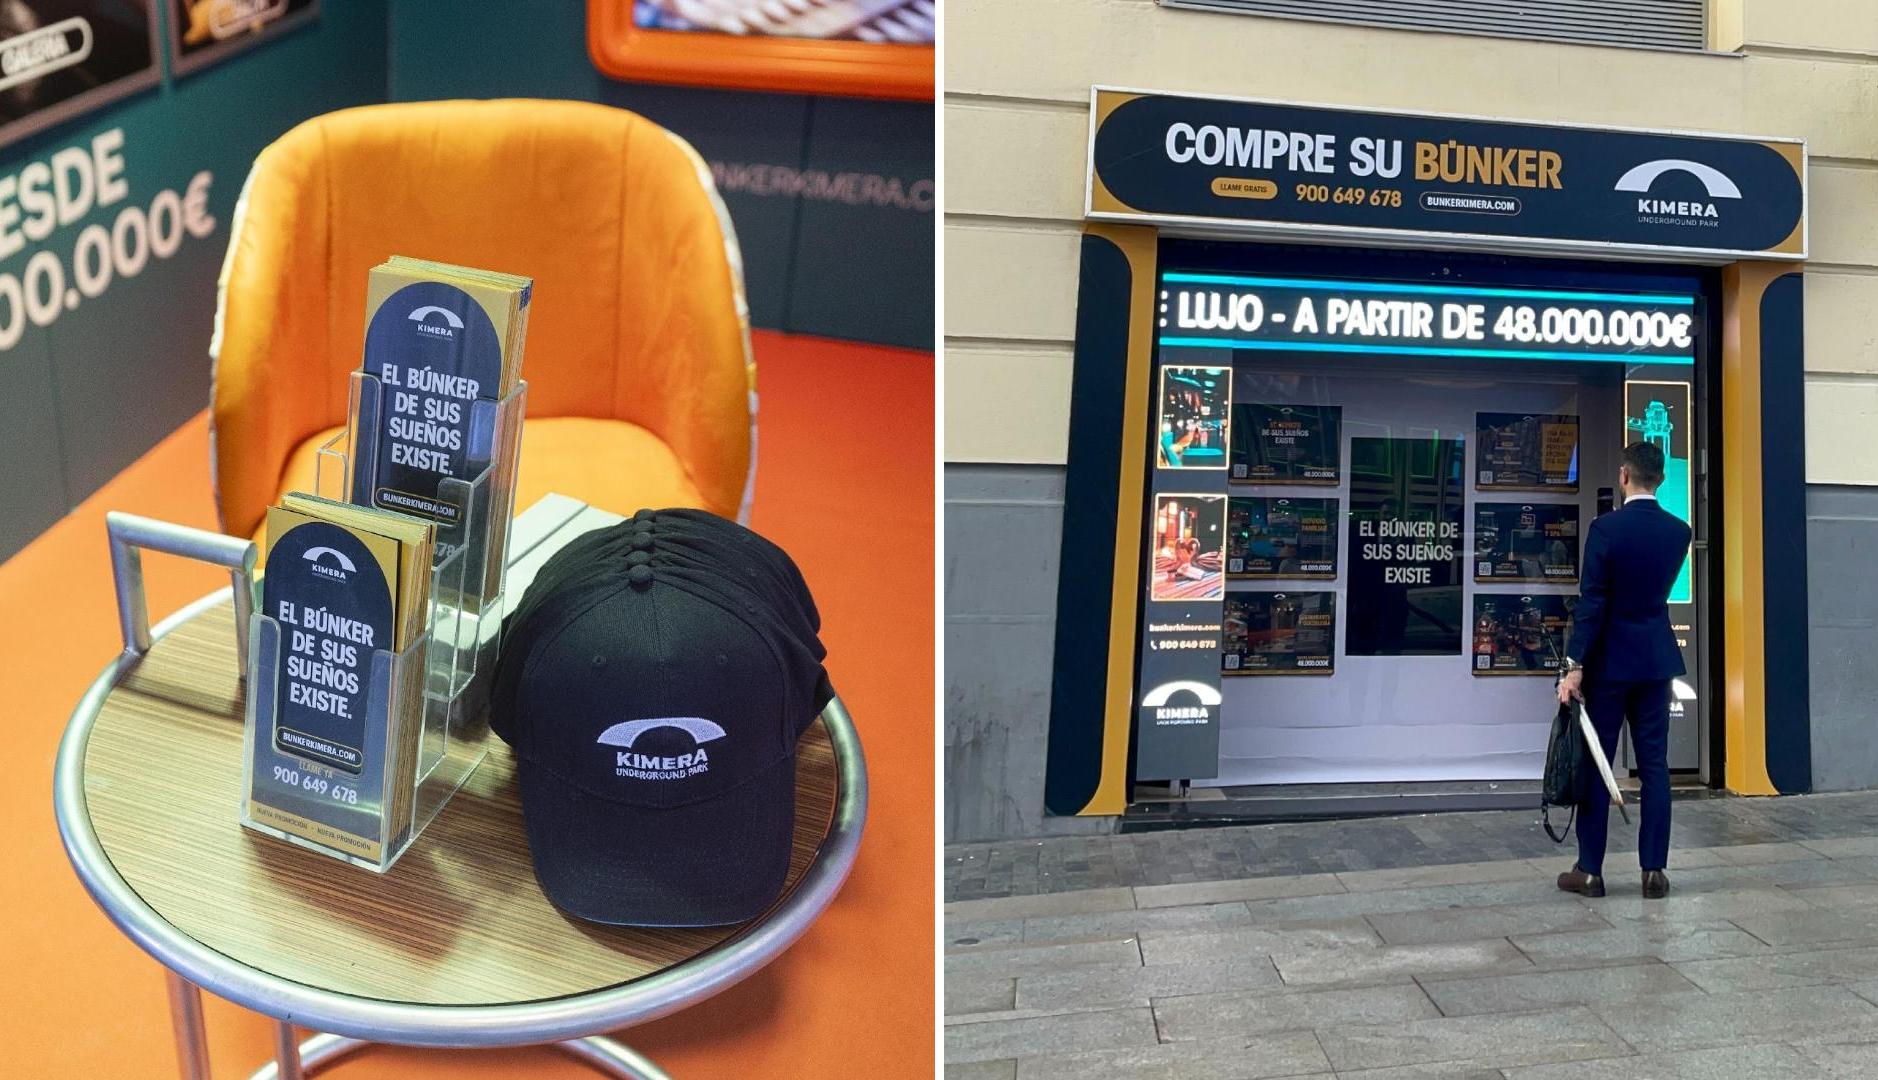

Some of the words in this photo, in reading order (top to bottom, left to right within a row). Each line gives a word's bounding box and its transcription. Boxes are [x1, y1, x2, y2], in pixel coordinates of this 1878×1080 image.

[1166, 122, 1335, 173] COMPRE
[1349, 137, 1402, 179] SU
[1296, 184, 1328, 202] 900
[1333, 186, 1364, 205] 649
[1369, 189, 1402, 208] 678
[1427, 196, 1515, 211] BUNKERKIMERA.COM
[1638, 199, 1719, 218] KIMERA
[1638, 216, 1697, 226] UNDERGROUND
[1700, 220, 1719, 228] PARK
[417, 324, 453, 337] KIMERA
[1178, 291, 1264, 332] LUJO
[1292, 297, 1319, 334] A
[1327, 298, 1433, 338] PARTIR
[1442, 304, 1485, 340] DE
[1493, 306, 1692, 348] 48.000.000€
[382, 363, 401, 386] EL
[407, 366, 479, 400] BÚNKER
[395, 392, 418, 415] DE
[424, 398, 460, 424] SUS
[389, 417, 461, 450] SUEÑOS
[391, 442, 454, 475] EXISTE.
[1359, 520, 1374, 537] EL
[1379, 518, 1436, 538] BÚNKER
[1440, 522, 1458, 538] DE
[1363, 544, 1392, 560] SUS
[1396, 541, 1454, 561] SUEÑOS
[312, 564, 346, 580] KIMERA
[1384, 568, 1431, 584] EXISTE
[279, 601, 298, 626] EL
[304, 606, 374, 647] BÚNKER
[292, 631, 315, 655] DE
[321, 638, 357, 668] SUS
[1160, 640, 1178, 649] 900
[287, 656, 359, 695] SUEÑOS
[290, 682, 352, 719] EXISTE.
[1156, 707, 1208, 719] KIMERA
[283, 732, 356, 762] BUNKERKIMERA.COM
[616, 748, 708, 770] KIMERA
[616, 768, 686, 780] UNDERGROUND
[688, 763, 709, 777] PARK
[273, 766, 299, 786] 900
[303, 776, 328, 794] 649
[332, 786, 358, 804] 678
